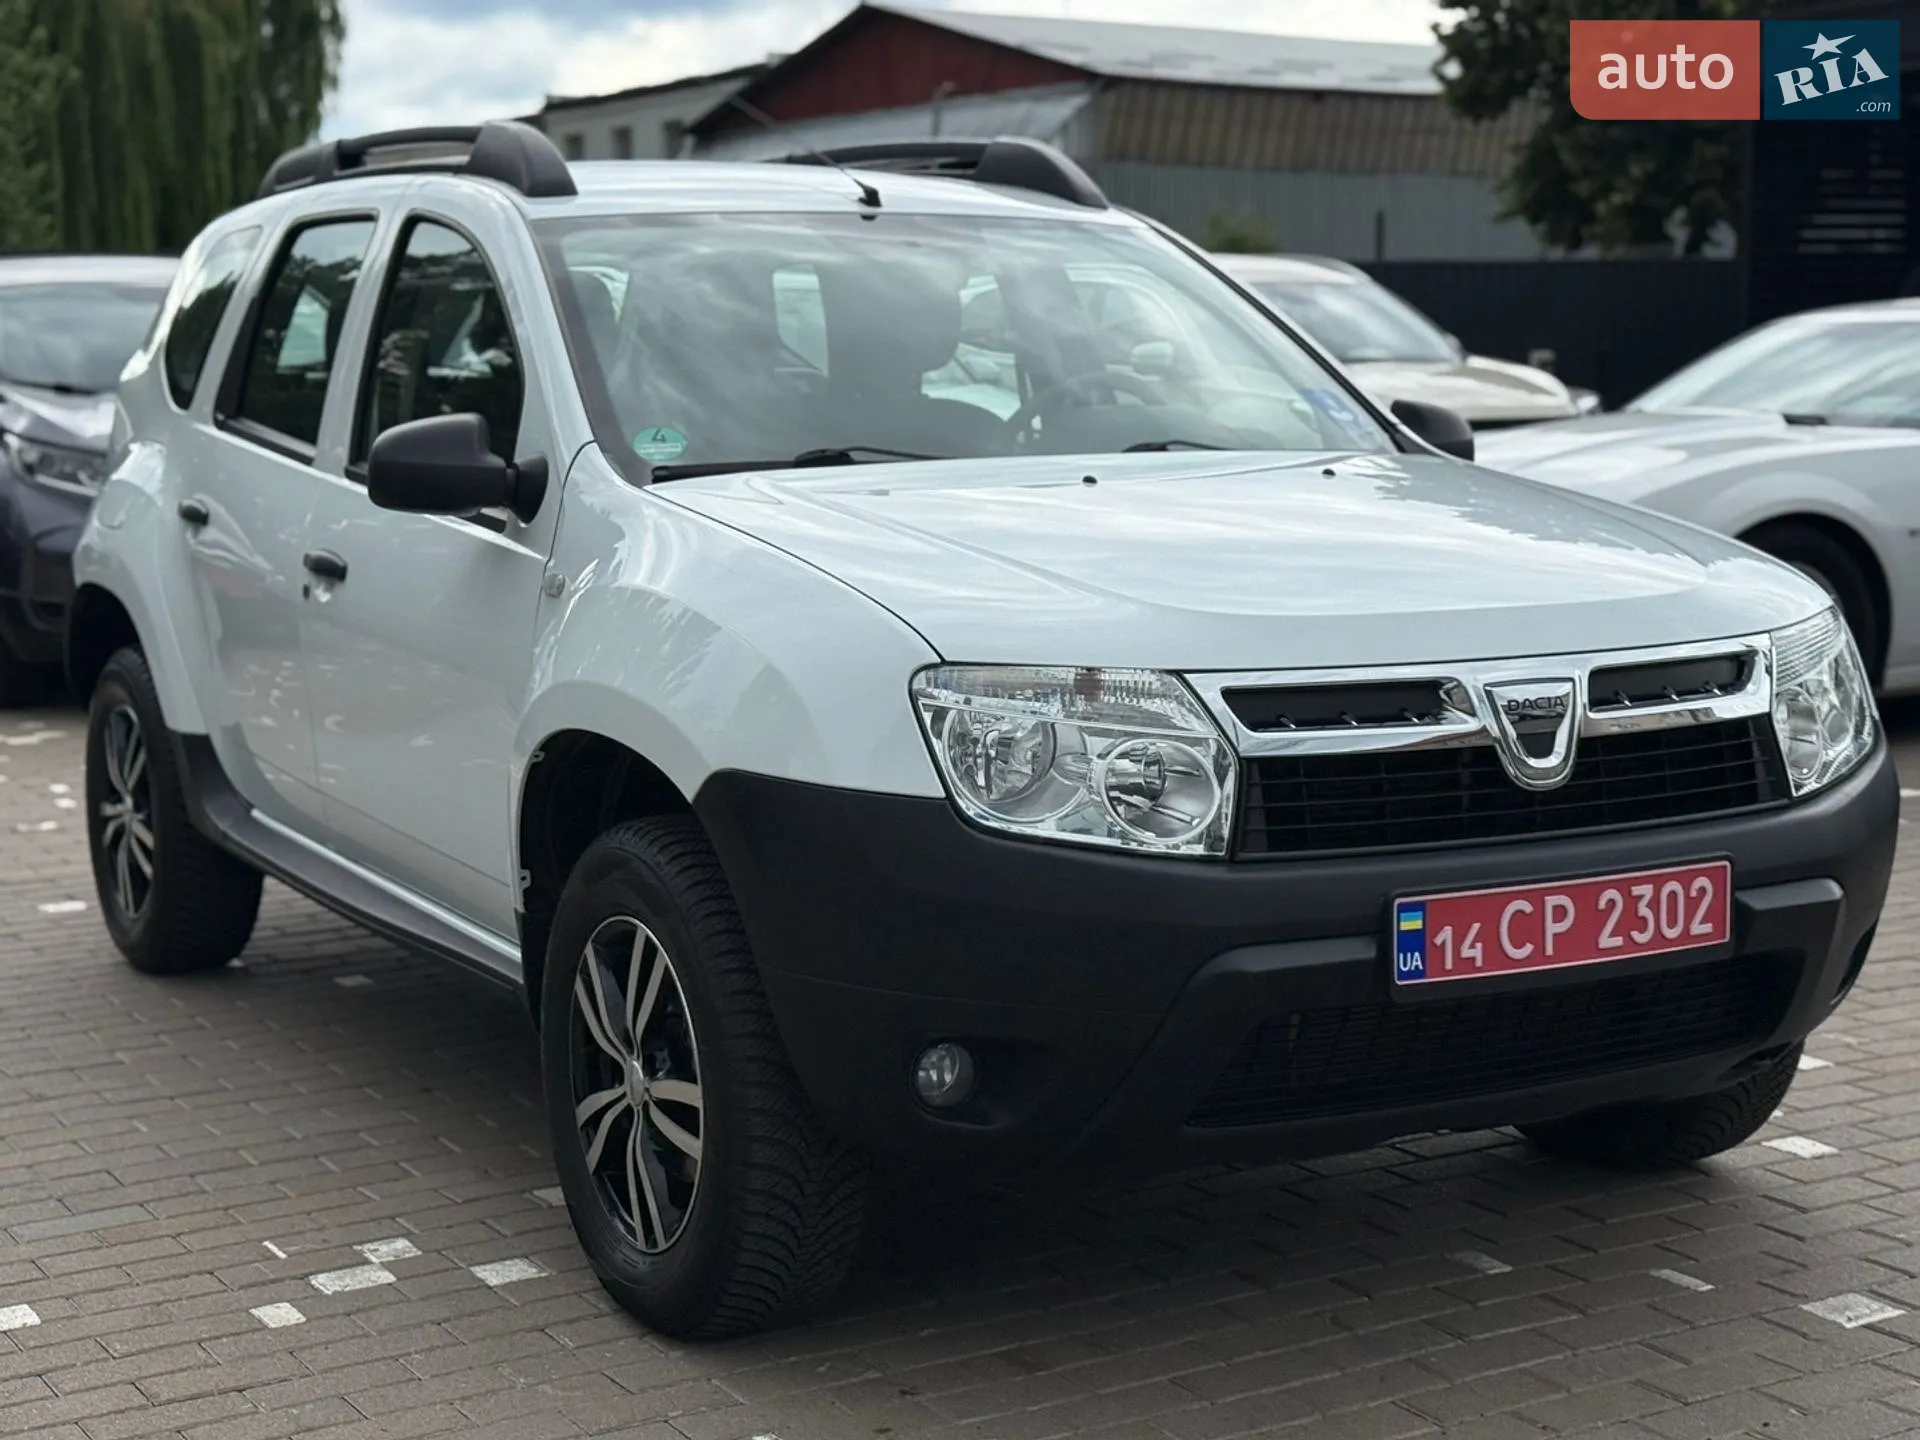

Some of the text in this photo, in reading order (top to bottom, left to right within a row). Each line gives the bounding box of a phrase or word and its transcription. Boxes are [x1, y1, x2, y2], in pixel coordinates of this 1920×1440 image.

[651, 427, 667, 443] 4
[1507, 696, 1565, 712] DACIA
[1433, 876, 1714, 970] 14 CP 2302
[1399, 950, 1424, 972] UA
